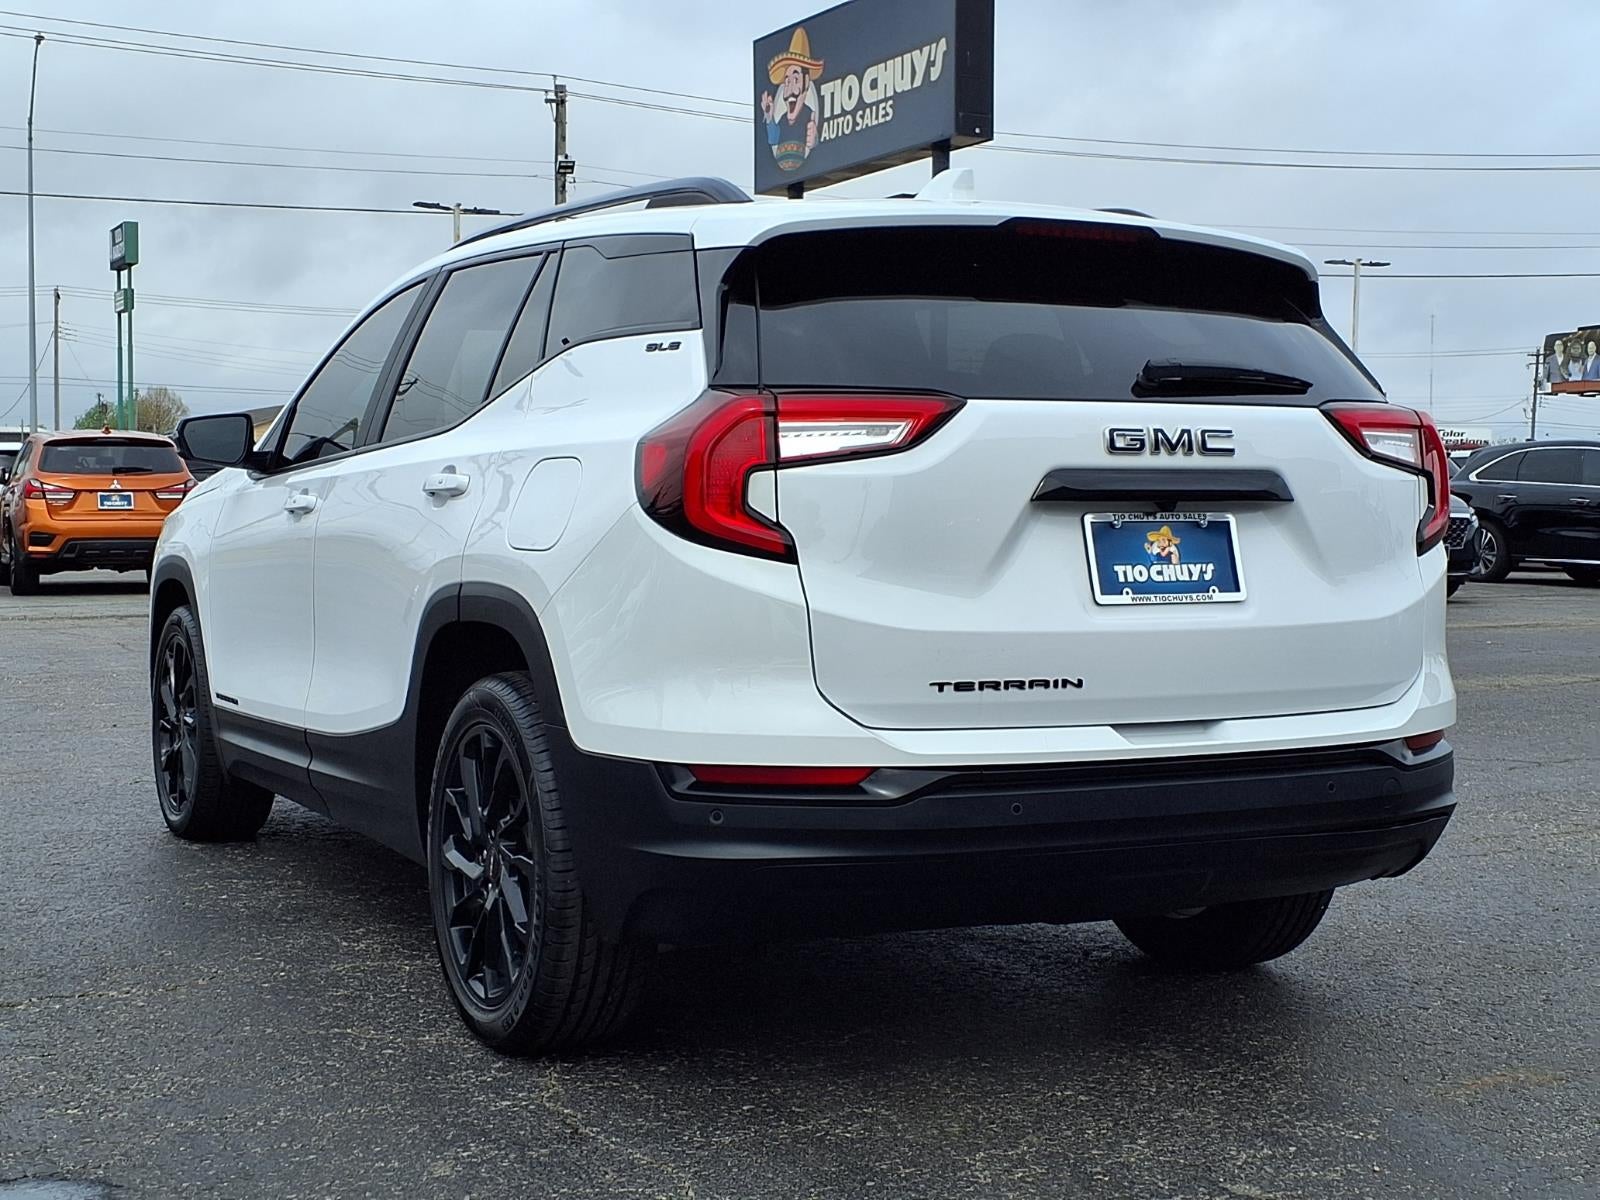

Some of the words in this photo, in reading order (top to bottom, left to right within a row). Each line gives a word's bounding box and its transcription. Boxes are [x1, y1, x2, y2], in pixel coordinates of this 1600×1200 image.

[820, 74, 860, 119] TIO
[861, 37, 947, 104] CHUY'S
[820, 114, 853, 143] AUTO
[855, 100, 894, 132] SALES
[1103, 426, 1236, 457] GMC
[1182, 513, 1208, 521] SALES
[1113, 564, 1148, 584] TIO
[1149, 563, 1215, 582] CHUY'S
[1130, 594, 1214, 603] WWW.TIOCHUYS.COM
[929, 678, 1084, 693] TERRAIN
